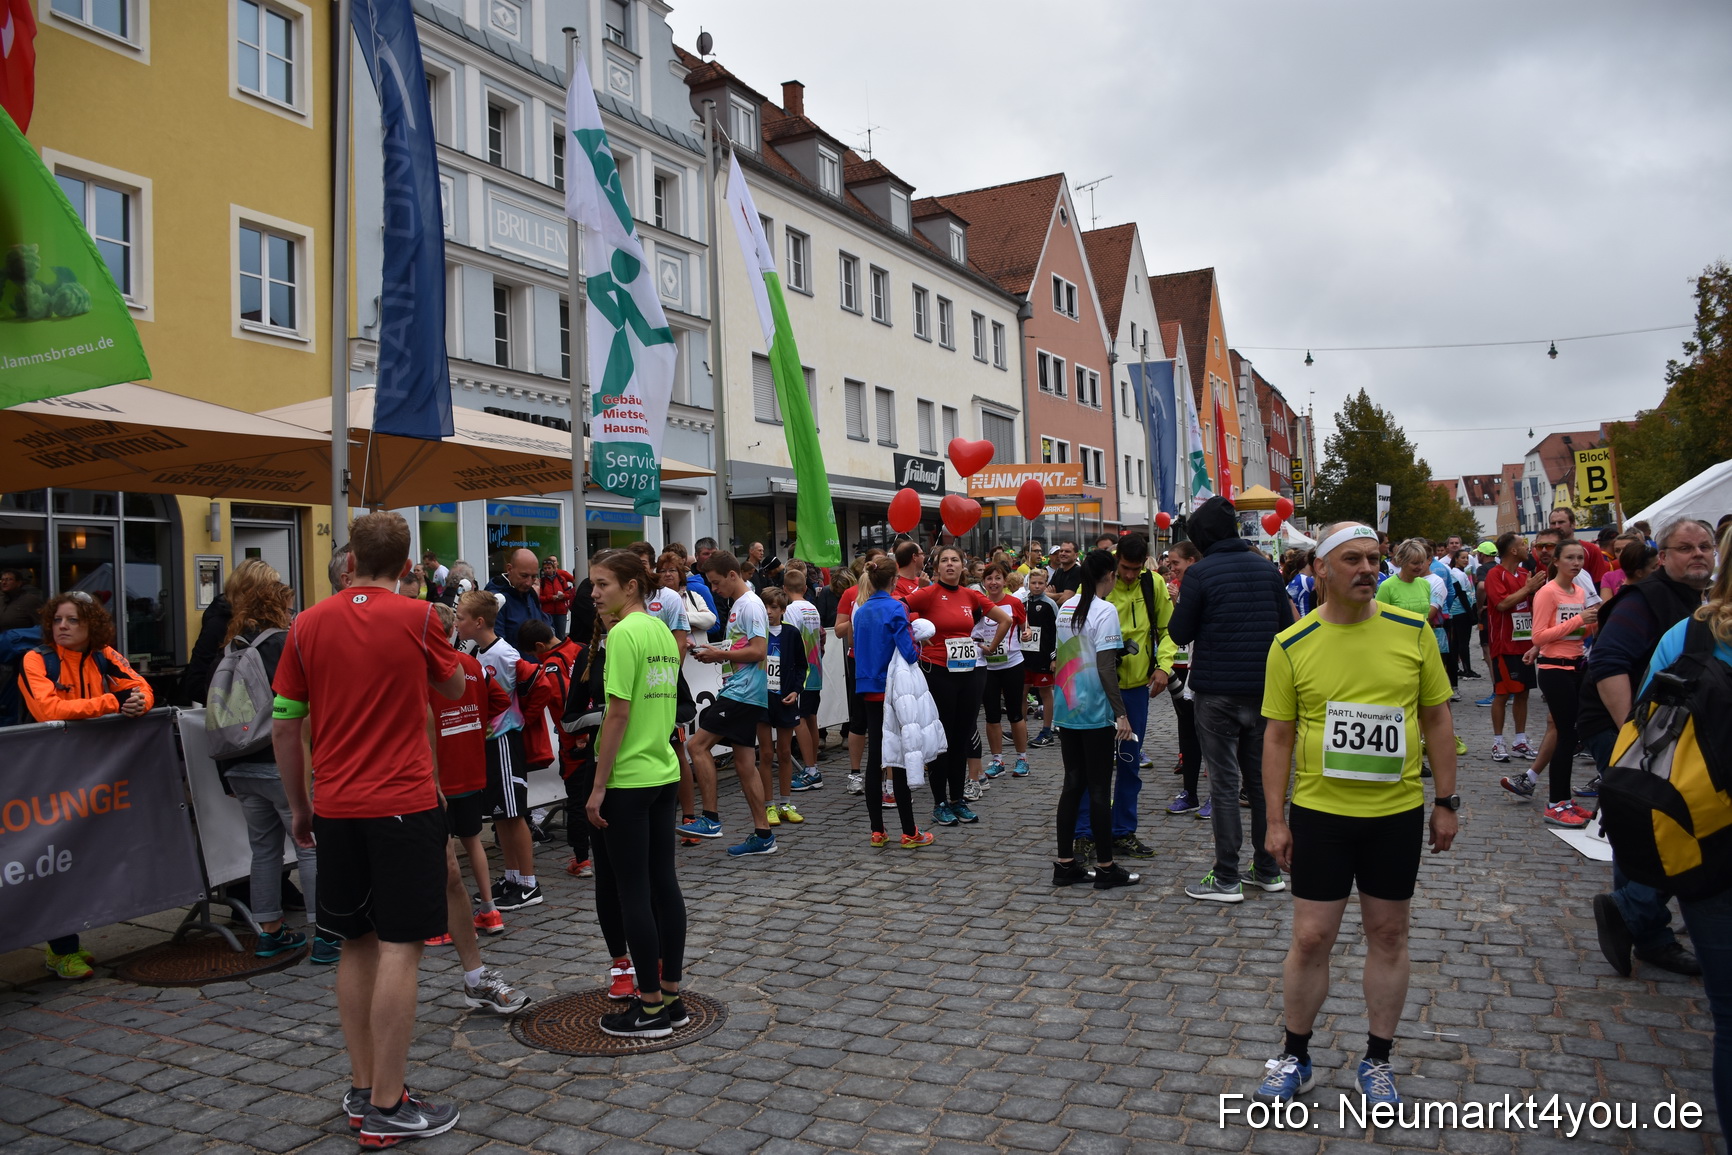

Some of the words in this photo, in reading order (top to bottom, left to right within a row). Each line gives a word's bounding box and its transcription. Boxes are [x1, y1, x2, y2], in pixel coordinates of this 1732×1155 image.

[496, 208, 569, 257] BRILLEN
[1579, 450, 1610, 463] Block
[607, 472, 656, 490] 09181
[1587, 466, 1608, 493] B
[317, 522, 331, 536] 24
[950, 645, 976, 659] 2785
[1328, 708, 1354, 718] PARTL
[1356, 711, 1392, 721] Neumarkt
[1332, 721, 1399, 753] 5340
[0, 780, 132, 834] OUNGE
